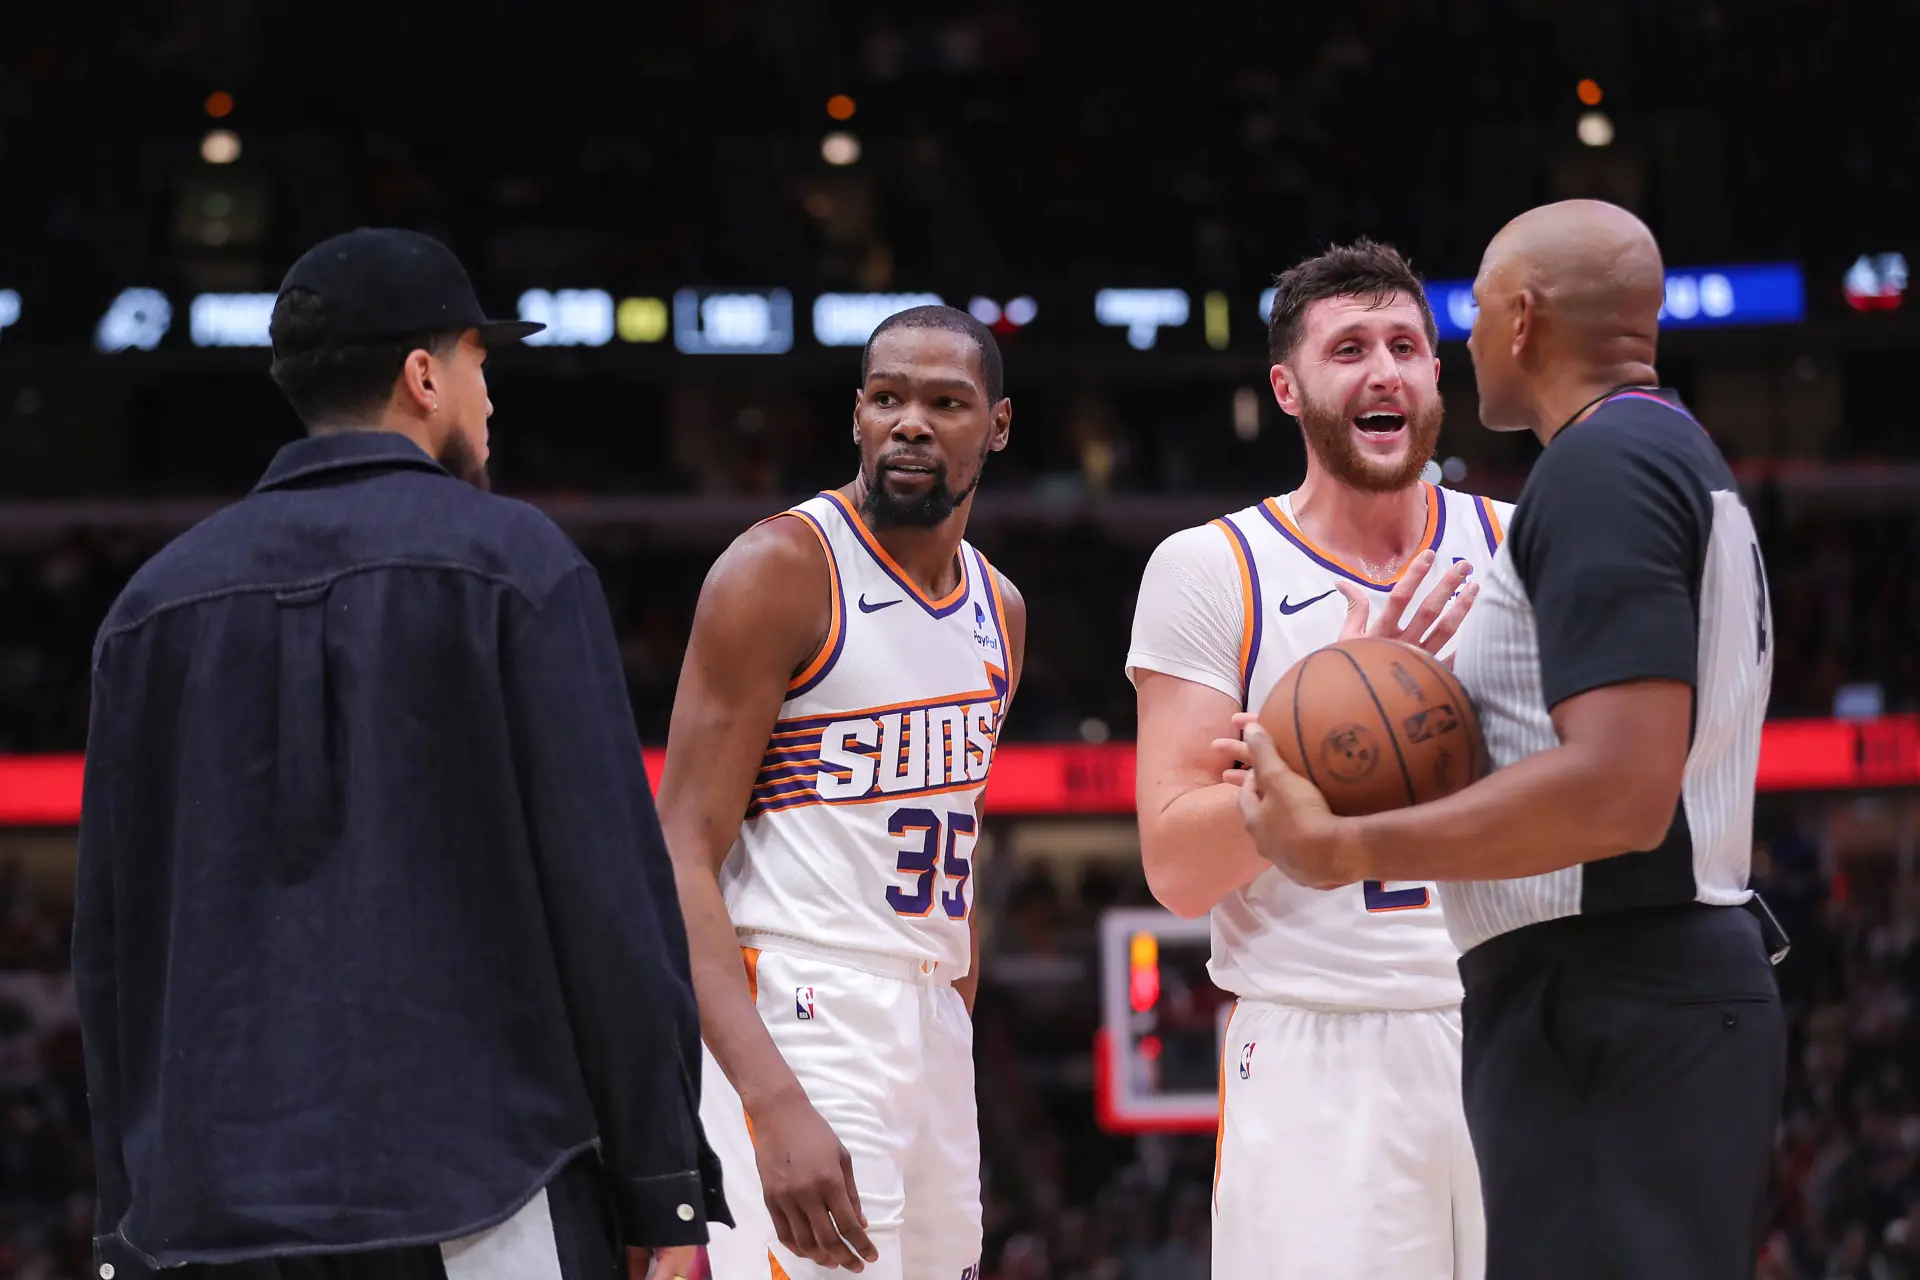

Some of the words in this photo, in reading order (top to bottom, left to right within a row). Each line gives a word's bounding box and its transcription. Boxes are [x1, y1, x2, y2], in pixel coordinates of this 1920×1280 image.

[974, 629, 998, 650] PayPal
[815, 703, 994, 800] SUNS
[885, 807, 976, 921] 35
